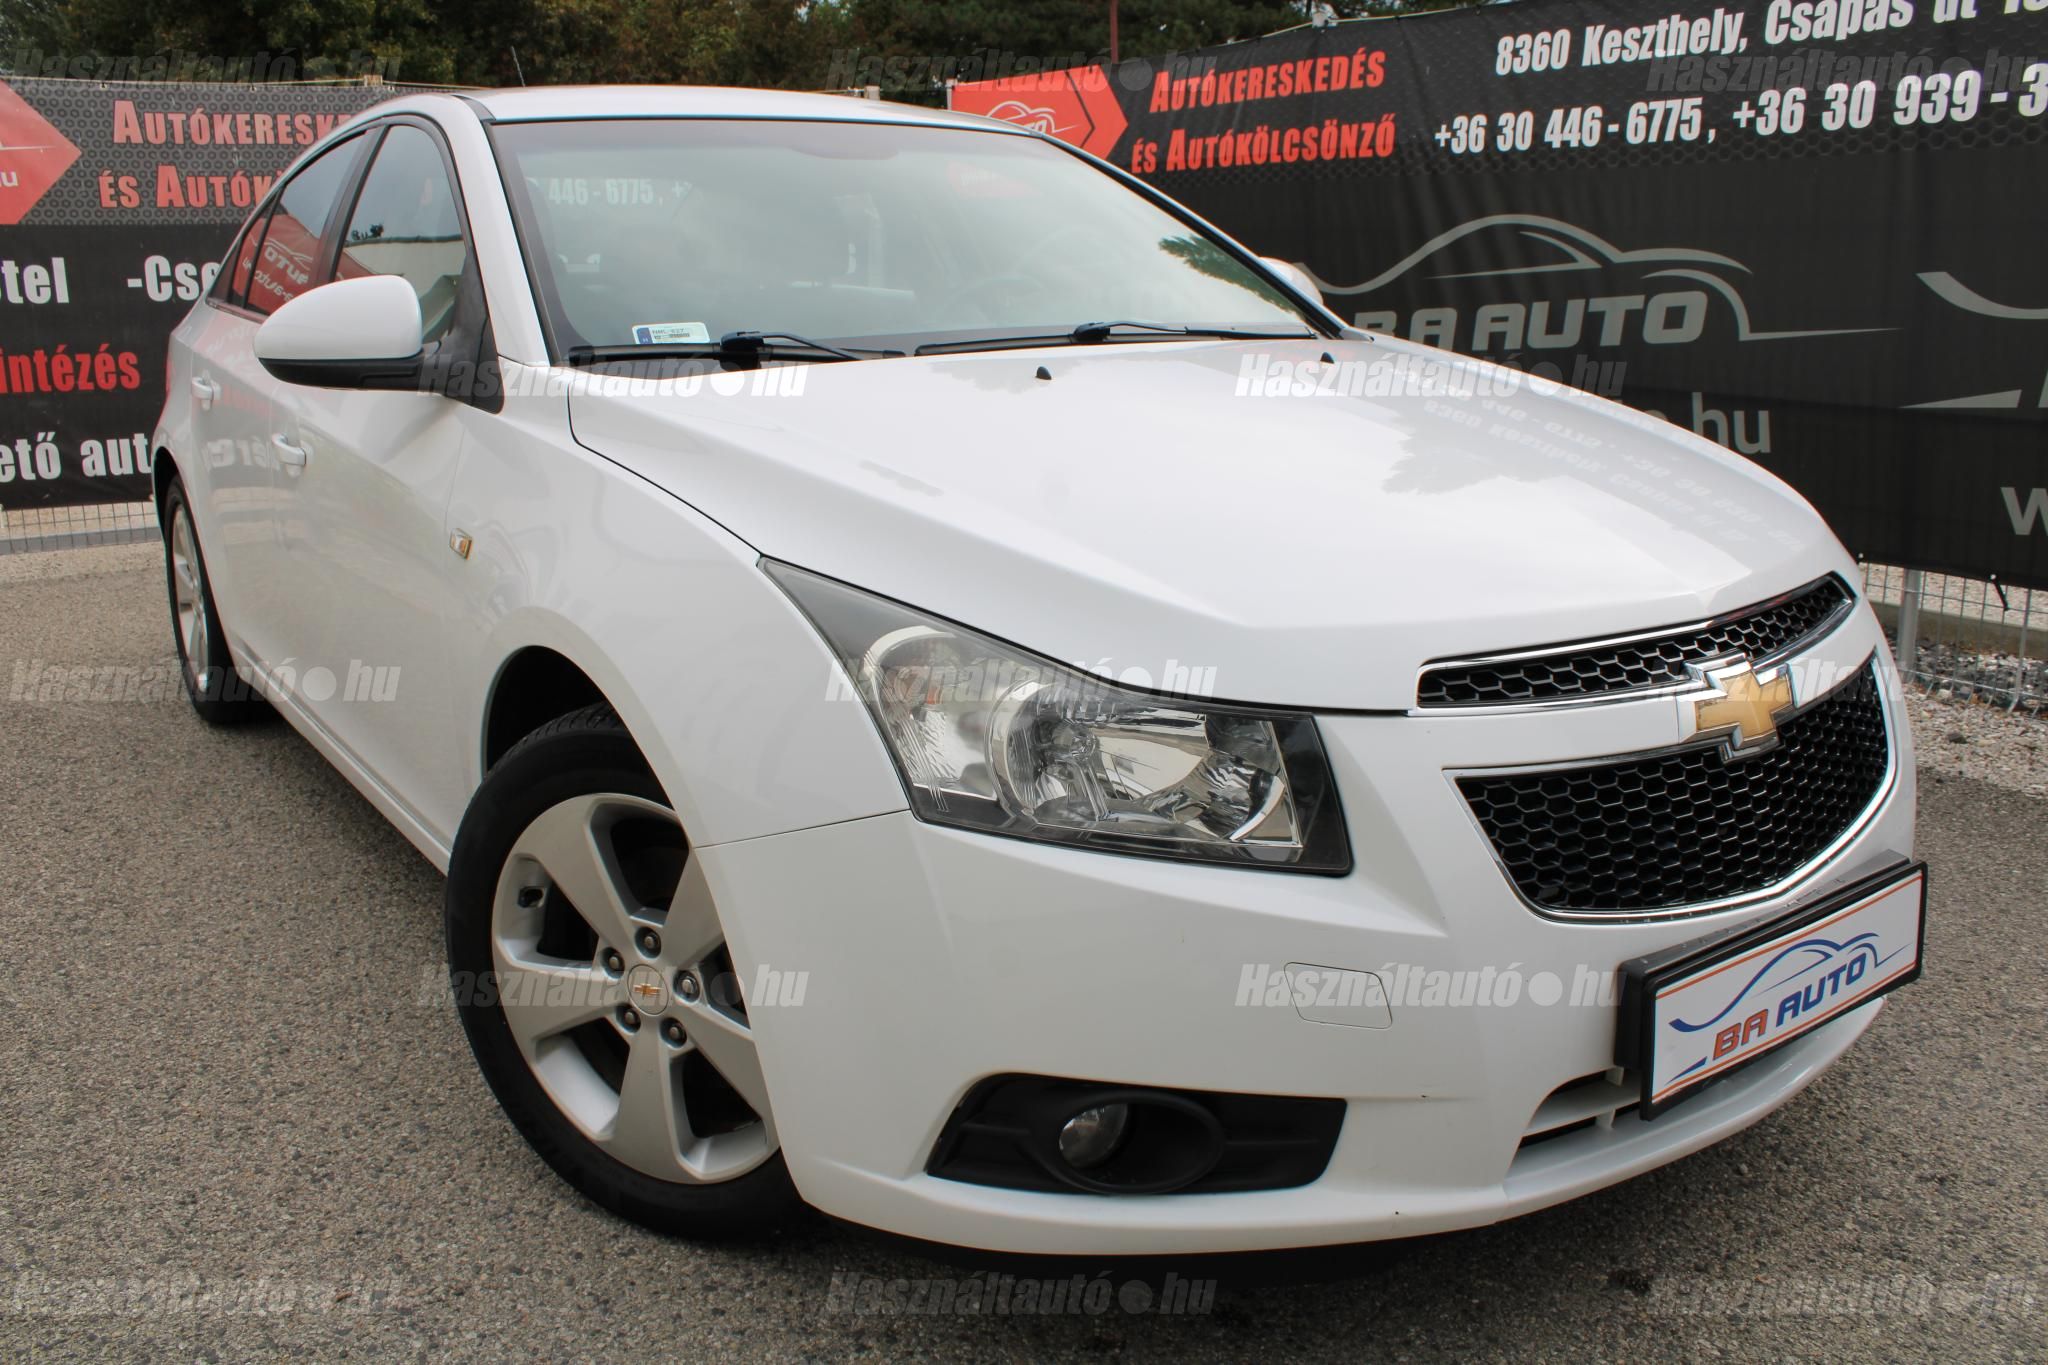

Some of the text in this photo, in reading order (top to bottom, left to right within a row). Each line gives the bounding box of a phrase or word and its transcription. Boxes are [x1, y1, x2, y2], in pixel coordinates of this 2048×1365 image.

[1495, 28, 1571, 76] 8360
[1581, 7, 1748, 67] Keszthely,
[1149, 47, 1387, 113] AUTÓKERESKEDÉS
[113, 99, 353, 146] AUTÓKERESK
[1131, 113, 1397, 174] ÉS AUTÓKÖLCSÖNZŐ
[1434, 114, 1487, 154] +36
[1496, 111, 1534, 152] 30
[1732, 87, 1808, 136] +36
[1821, 80, 1877, 131] 30
[99, 165, 284, 208] ÉS AUTÓK
[0, 255, 70, 304] tel
[1471, 290, 1709, 352] AUTO
[1712, 953, 1867, 1062] BA AUTO
